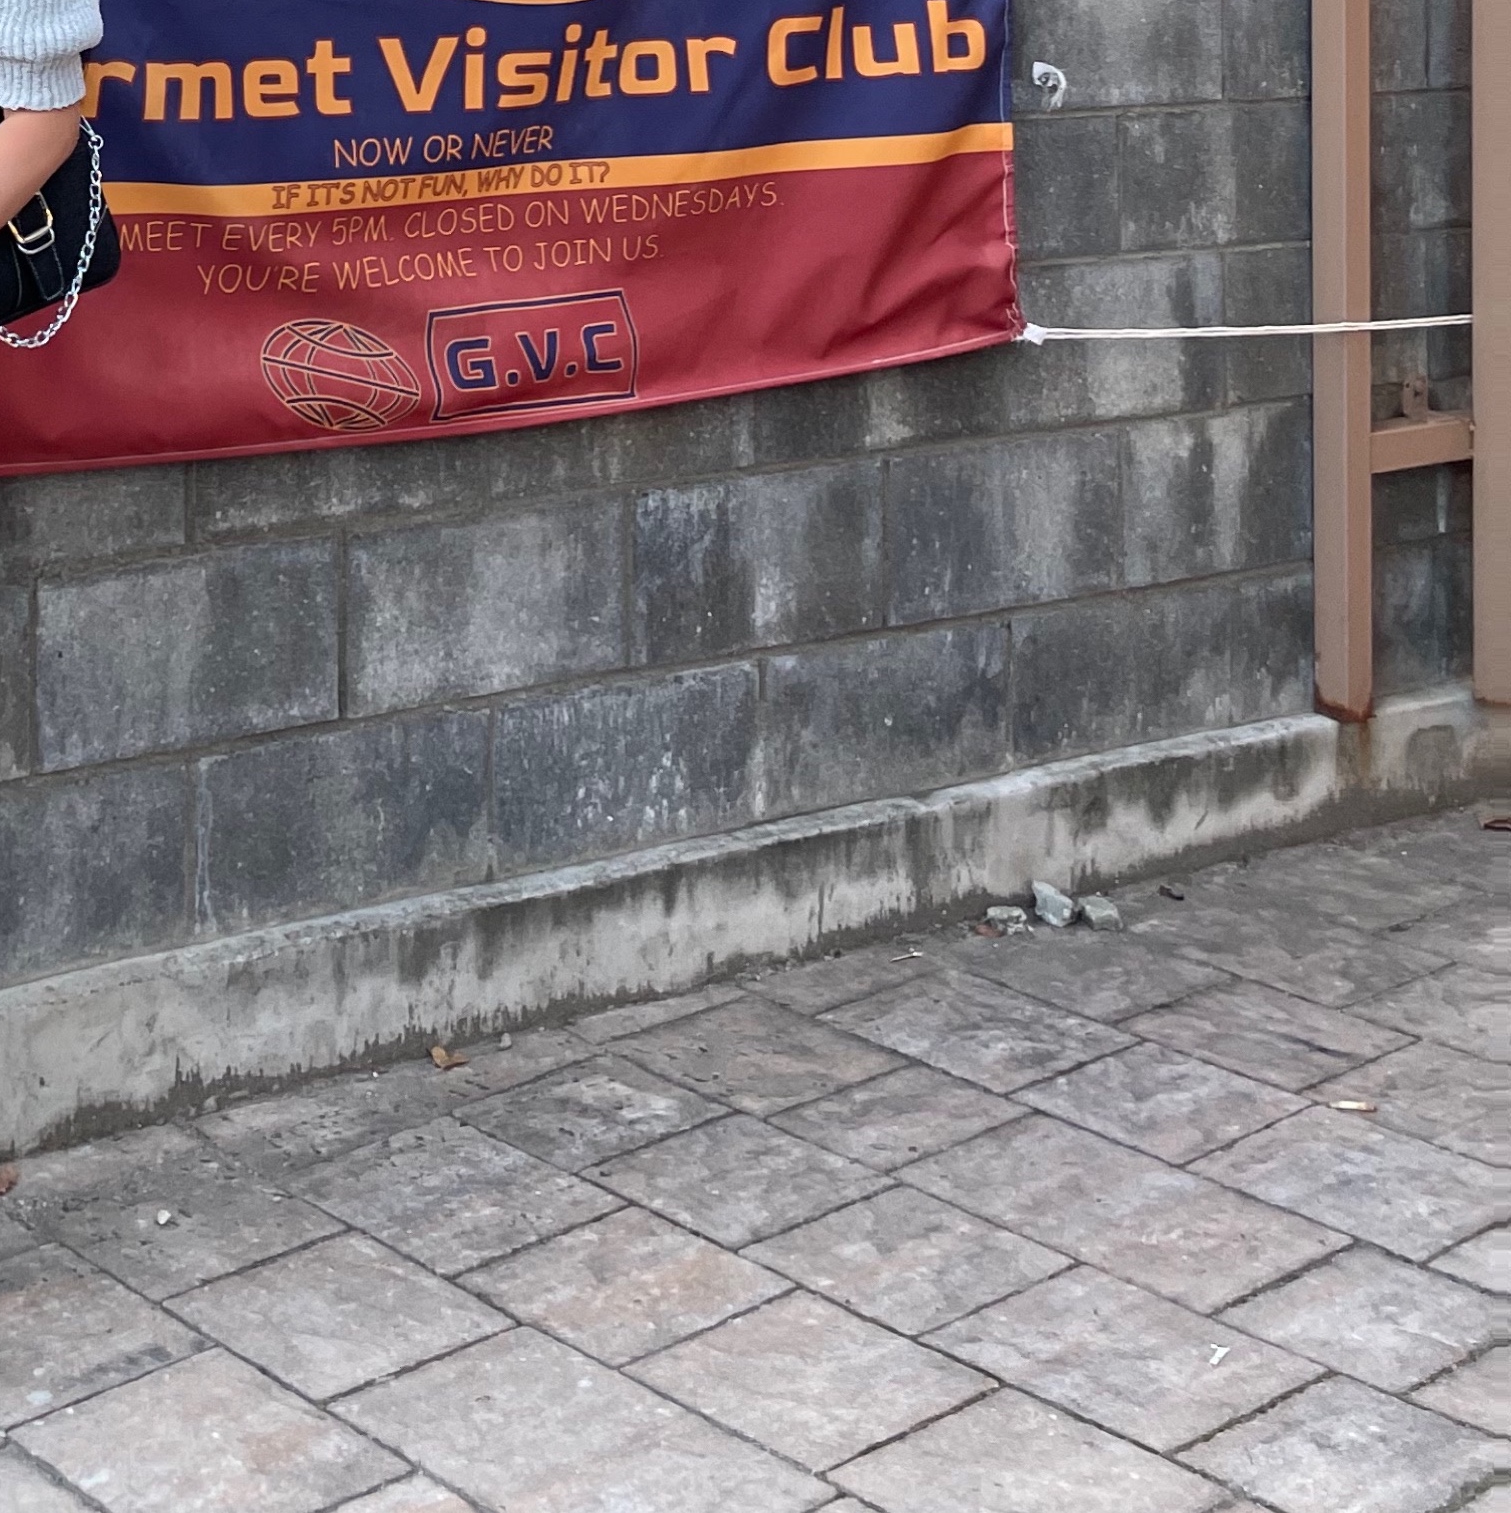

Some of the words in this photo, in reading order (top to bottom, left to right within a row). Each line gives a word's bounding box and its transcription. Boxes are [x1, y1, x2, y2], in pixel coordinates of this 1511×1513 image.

[79, 38, 352, 122] rmet
[378, 23, 737, 115] Visitor
[333, 136, 413, 169] NOW
[423, 134, 463, 164] OR
[470, 125, 554, 161] NEVER
[271, 184, 302, 210] IF
[360, 178, 416, 204] NOT
[417, 172, 468, 199] FUN,
[475, 165, 526, 194] WHY
[530, 163, 563, 187] DO
[568, 161, 611, 185] IT?
[119, 220, 213, 252] MEET
[222, 221, 323, 252] EVERY
[403, 202, 515, 239] CLOSED
[524, 199, 570, 229] ON
[196, 262, 321, 295] YOU'RE
[332, 247, 478, 291] WELCOME
[482, 245, 524, 272] TO
[533, 237, 612, 271] JOIN
[445, 320, 623, 391] G.V.C
